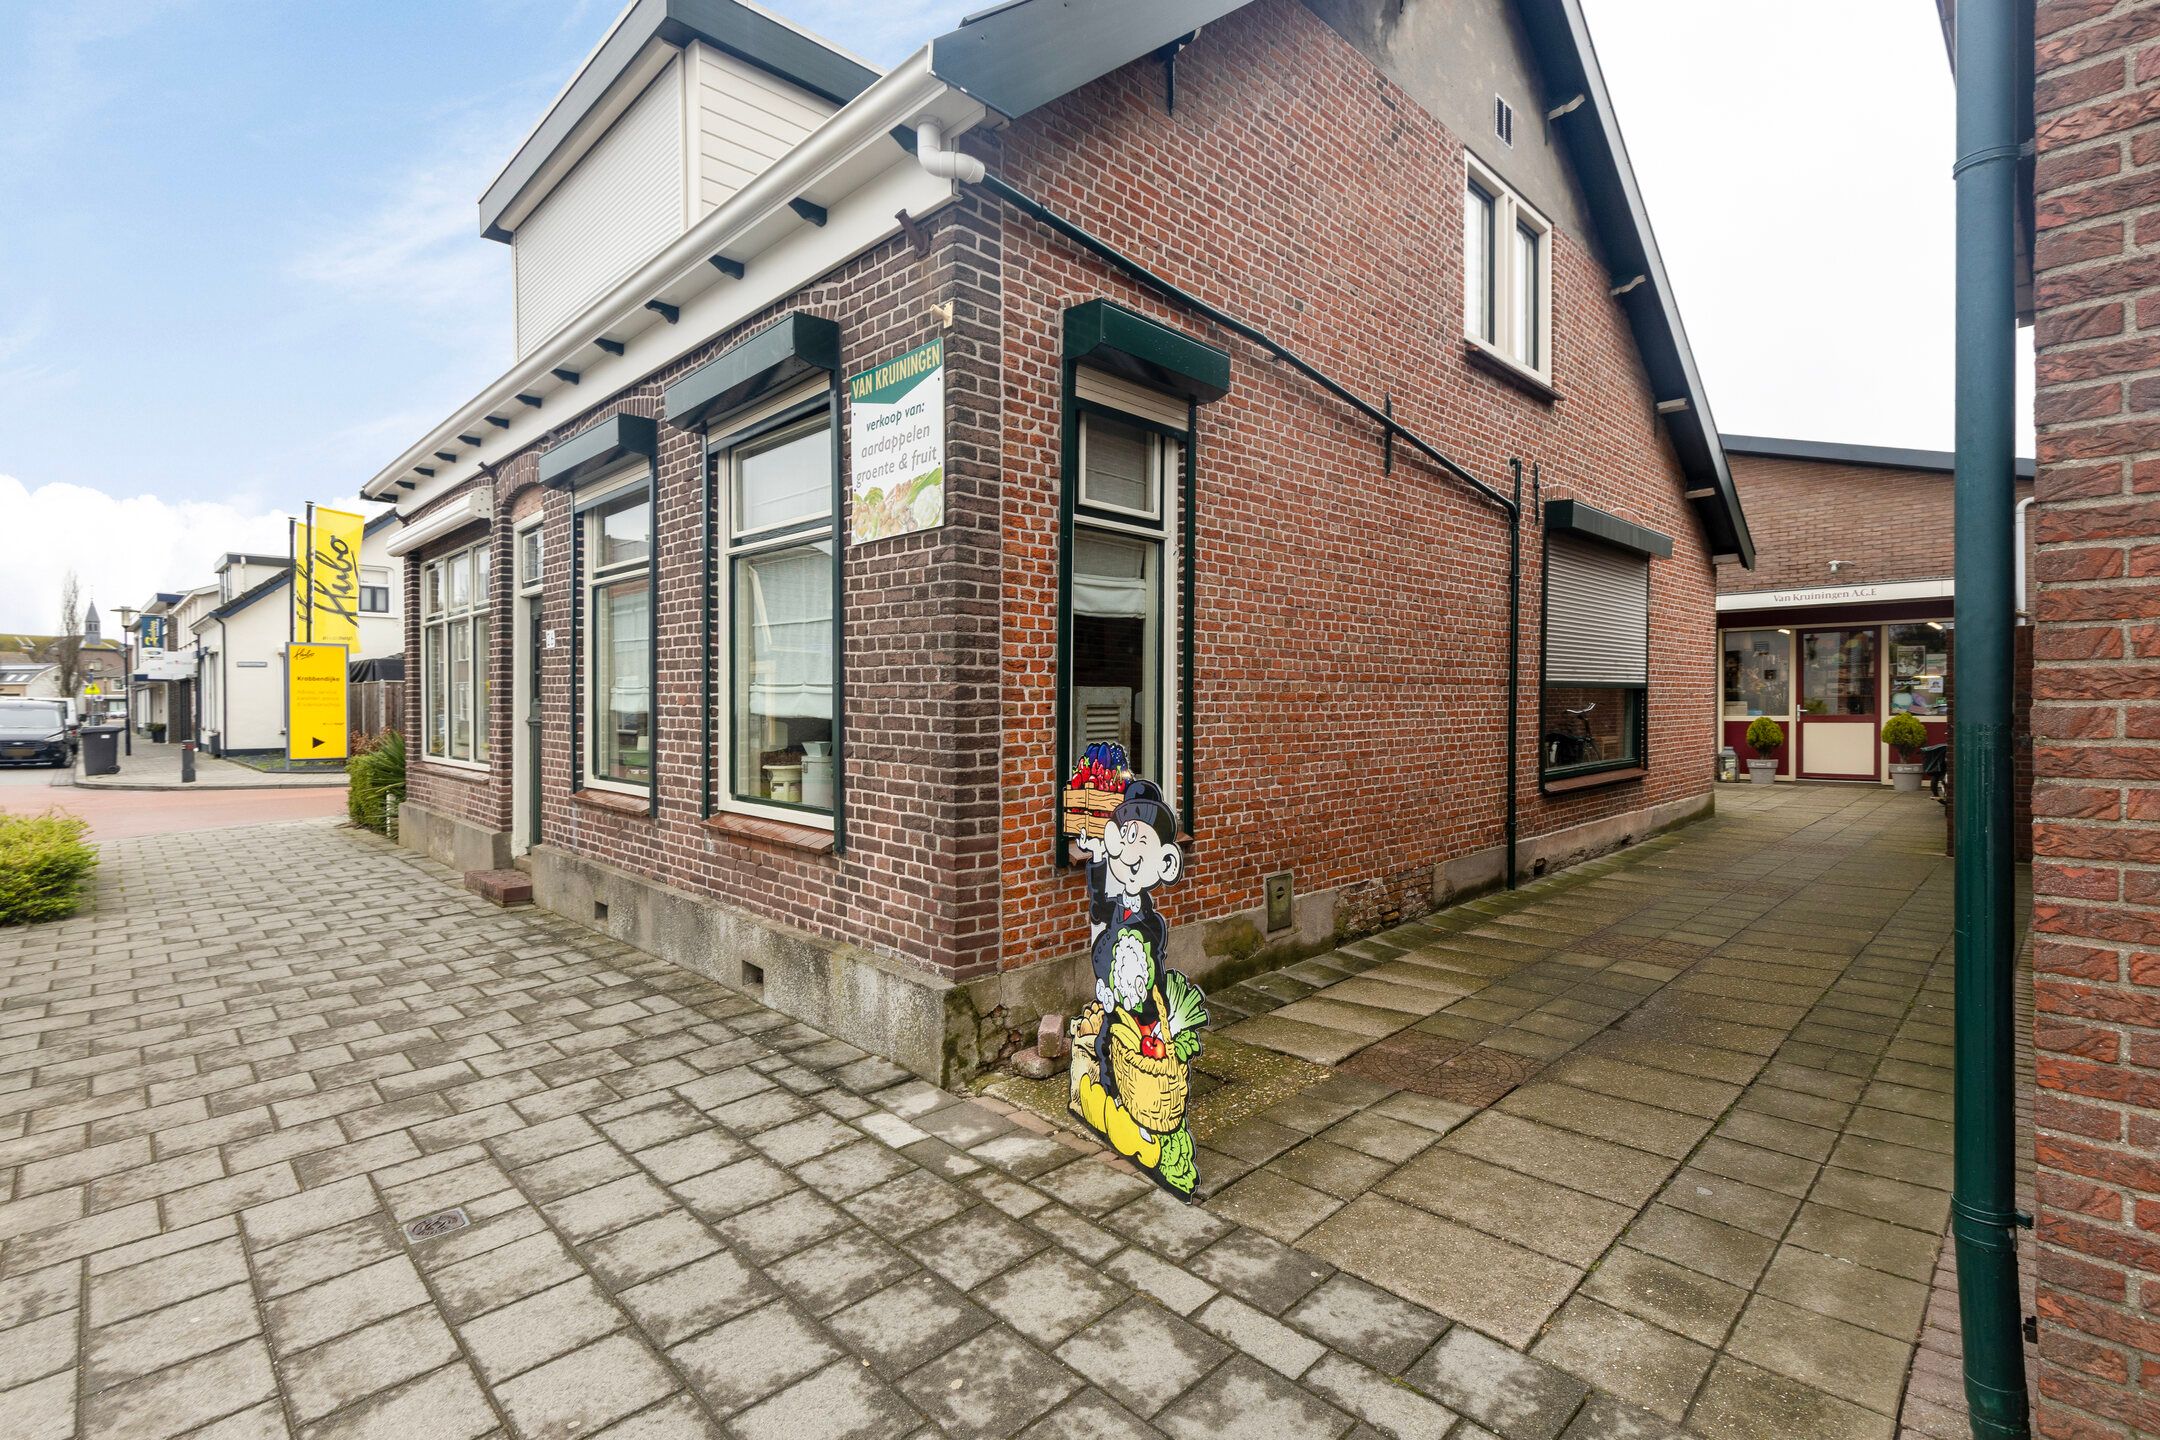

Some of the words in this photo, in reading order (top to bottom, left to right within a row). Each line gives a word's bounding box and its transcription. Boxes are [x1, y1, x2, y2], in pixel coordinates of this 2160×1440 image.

[852, 374, 872, 399] VAN
[875, 343, 940, 390] KRUININGEN
[866, 409, 902, 432] verkoop
[904, 402, 925, 418] van:
[861, 424, 930, 458] aardappelen
[856, 461, 895, 488] groente
[898, 453, 908, 470] &
[911, 446, 937, 471] fruit
[1773, 594, 1791, 602] Van
[1793, 590, 1849, 601] Kruiningen
